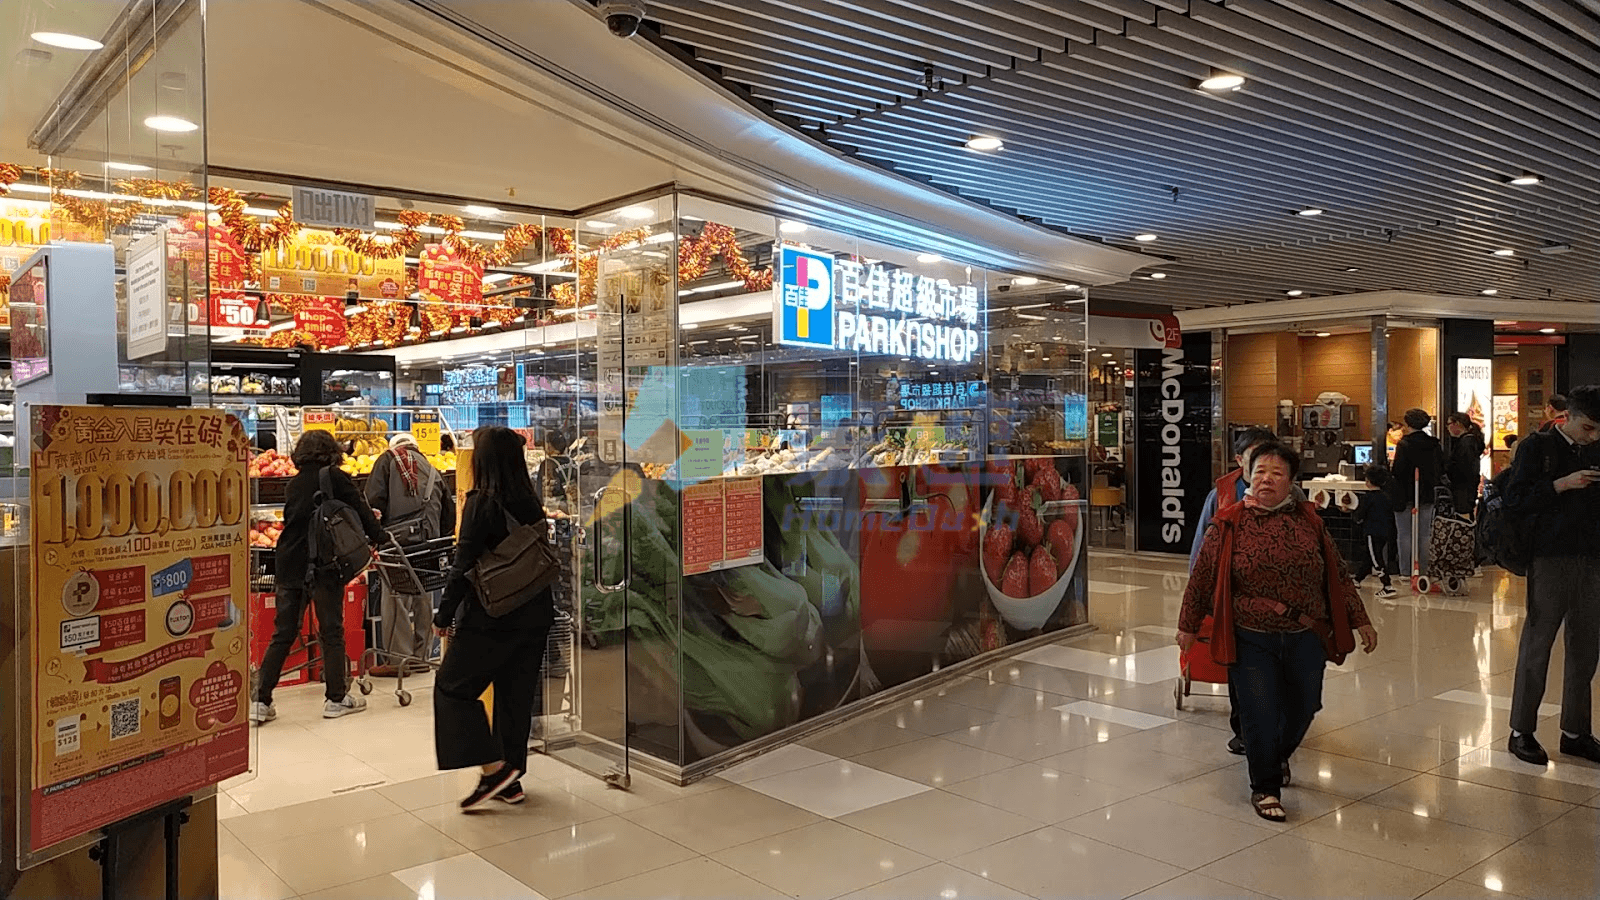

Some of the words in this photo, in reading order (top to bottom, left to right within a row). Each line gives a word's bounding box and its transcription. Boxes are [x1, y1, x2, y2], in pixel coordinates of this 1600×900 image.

[837, 259, 978, 325] 百佳超級市場
[1166, 327, 1180, 341] 2F
[74, 414, 224, 449] 黃金入屋笑住碌
[1161, 348, 1184, 543] McDonald's
[74, 465, 97, 475] share
[41, 468, 245, 548] 1,000,000
[216, 540, 232, 548] MILES
[162, 570, 187, 587] $800
[64, 633, 77, 643] $50
[58, 734, 77, 747] $128
